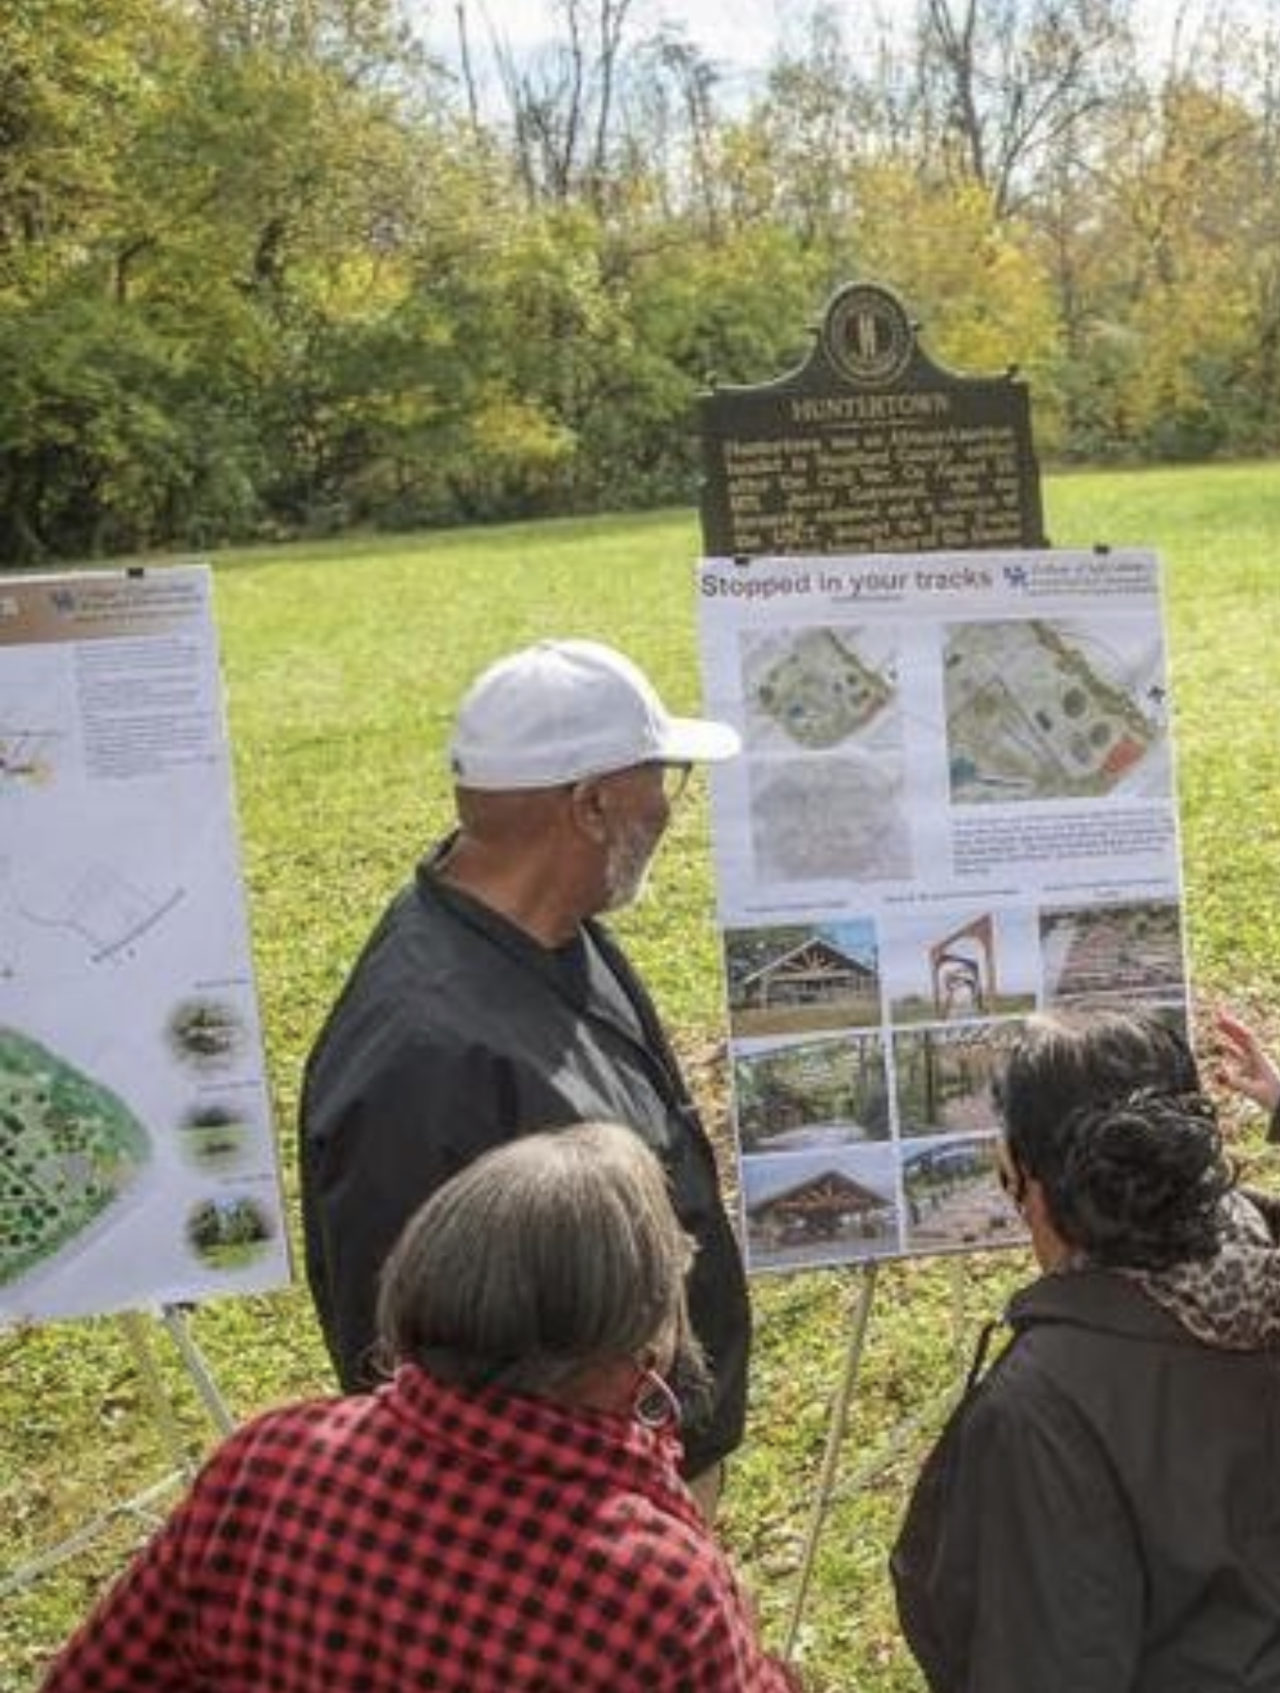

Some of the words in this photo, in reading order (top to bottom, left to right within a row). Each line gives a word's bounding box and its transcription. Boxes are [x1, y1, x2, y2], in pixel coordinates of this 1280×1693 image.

[701, 574, 811, 598] Stopped
[819, 572, 843, 593] in
[849, 571, 906, 597] your
[915, 567, 993, 591] tracks
